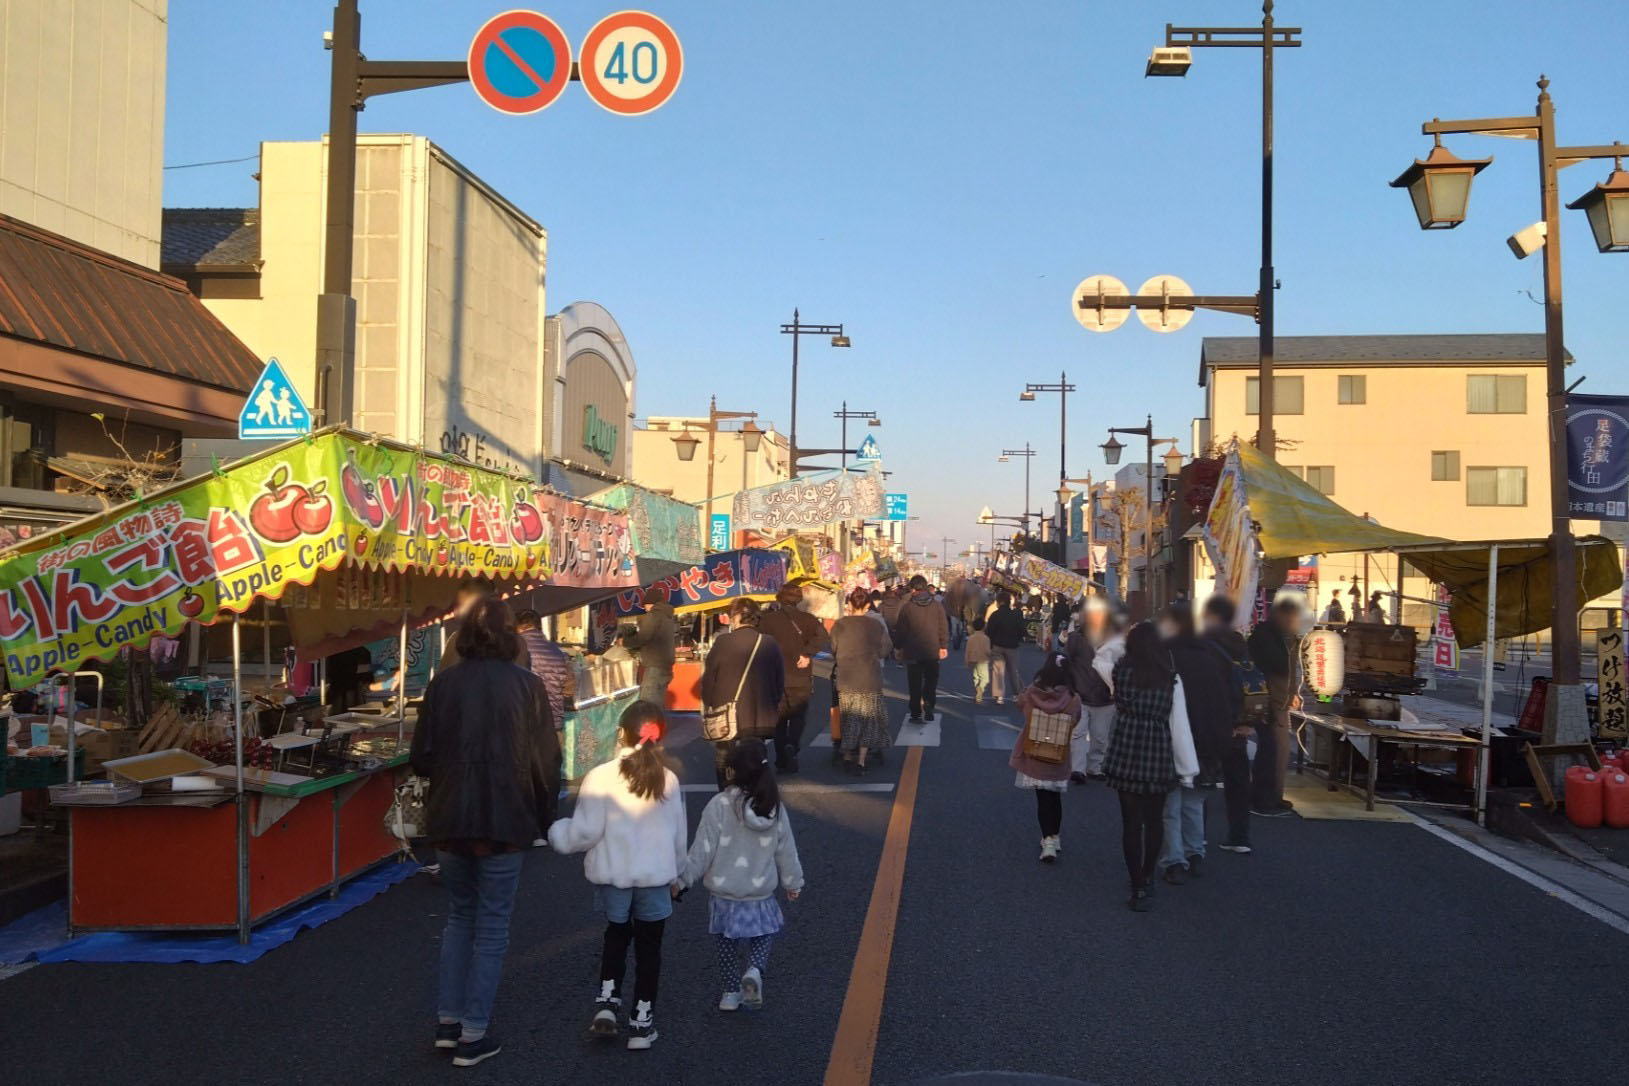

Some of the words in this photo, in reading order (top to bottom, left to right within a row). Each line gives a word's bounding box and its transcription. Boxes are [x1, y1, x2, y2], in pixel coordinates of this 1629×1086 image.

[603, 41, 658, 84] 40
[0, 508, 260, 641] りんご飴
[38, 501, 184, 576] 街の風物詩
[7, 606, 168, 676] Apple-Candy
[1601, 632, 1625, 732] つけ放題
